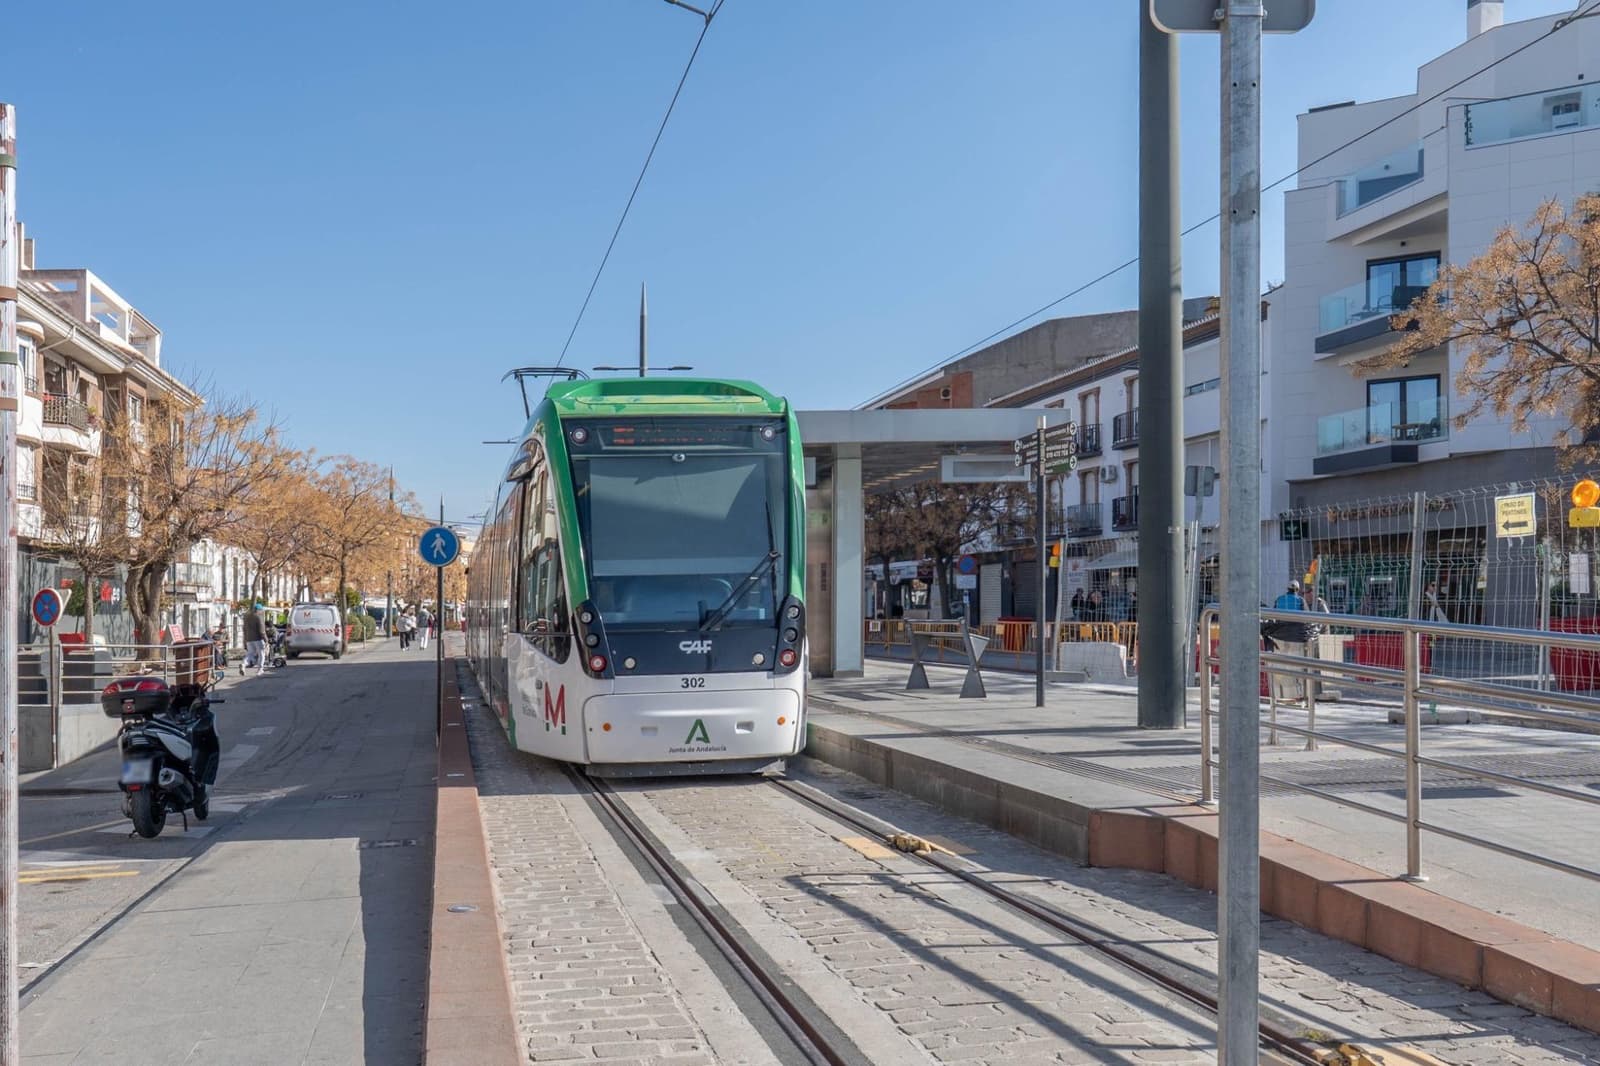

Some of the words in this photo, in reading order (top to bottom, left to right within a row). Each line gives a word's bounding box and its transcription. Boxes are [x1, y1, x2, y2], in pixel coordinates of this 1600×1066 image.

[679, 640, 713, 655] CAF
[681, 677, 705, 689] 302
[544, 681, 566, 735] M
[696, 745, 727, 753] Andalucía
